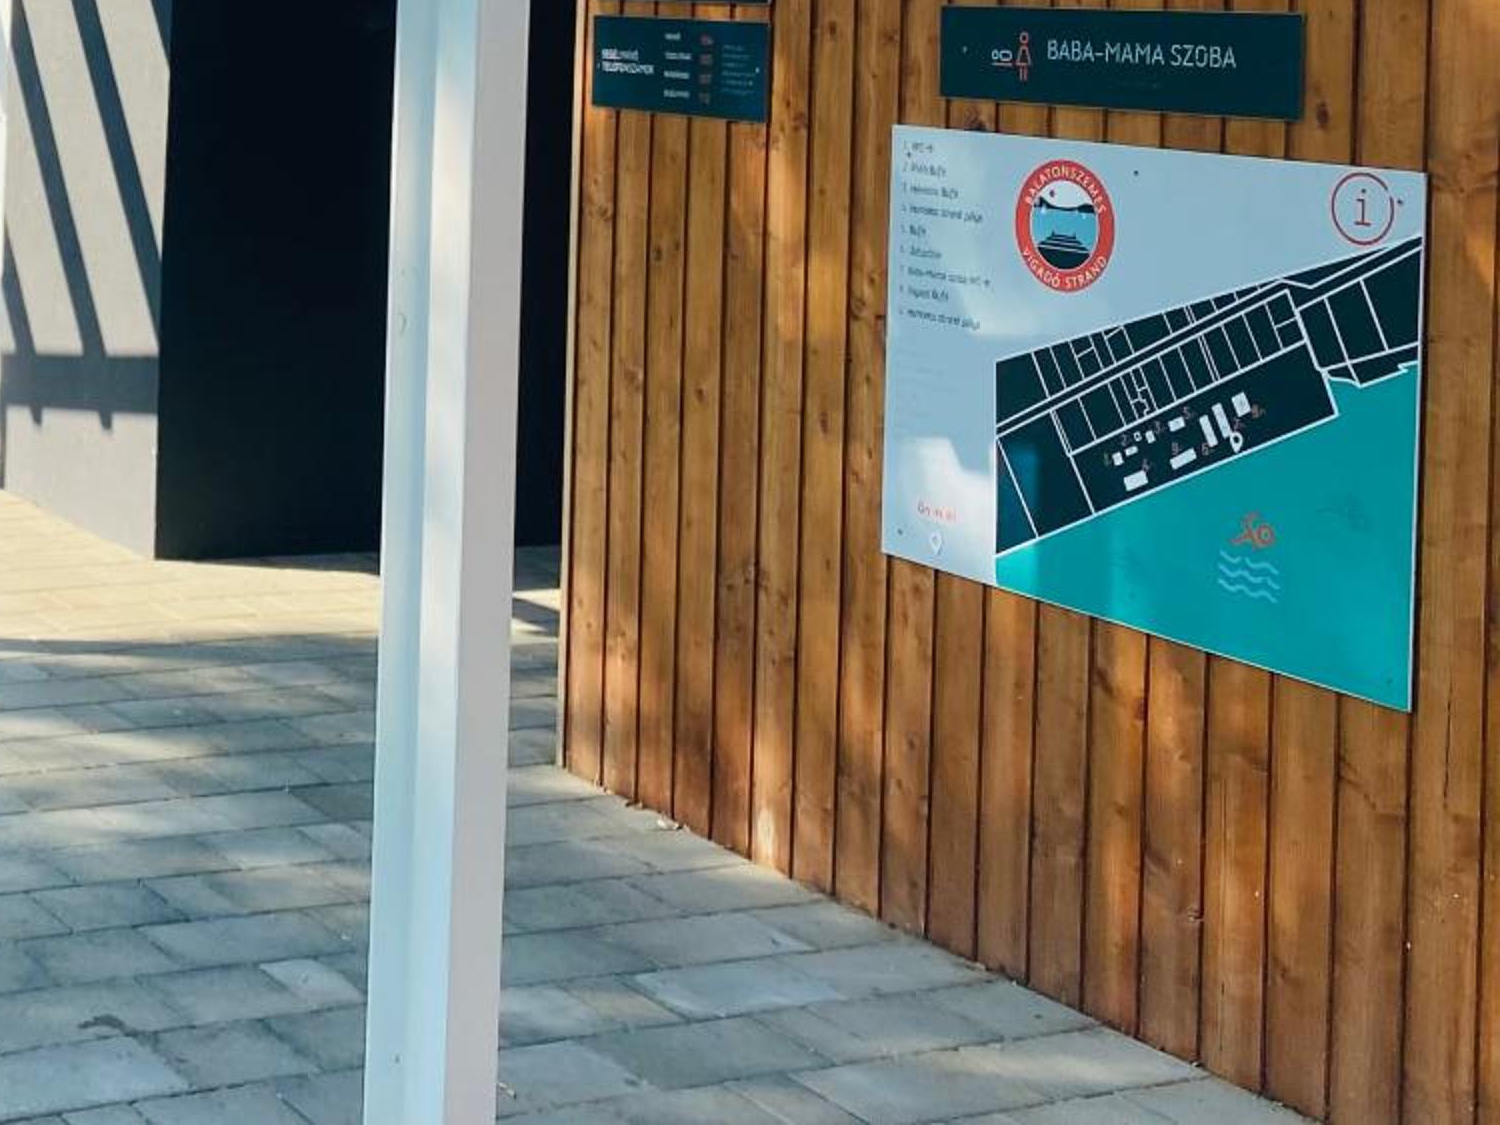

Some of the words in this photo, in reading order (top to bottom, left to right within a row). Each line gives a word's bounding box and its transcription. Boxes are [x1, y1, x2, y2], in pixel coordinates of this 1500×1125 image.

[1047, 39, 1165, 65] BABA-MAMA
[1170, 44, 1237, 69] SZOBA
[1025, 165, 1107, 214] BALATONSZEMES
[1023, 246, 1061, 287] VIGADÓ
[1065, 255, 1107, 289] STRAND
